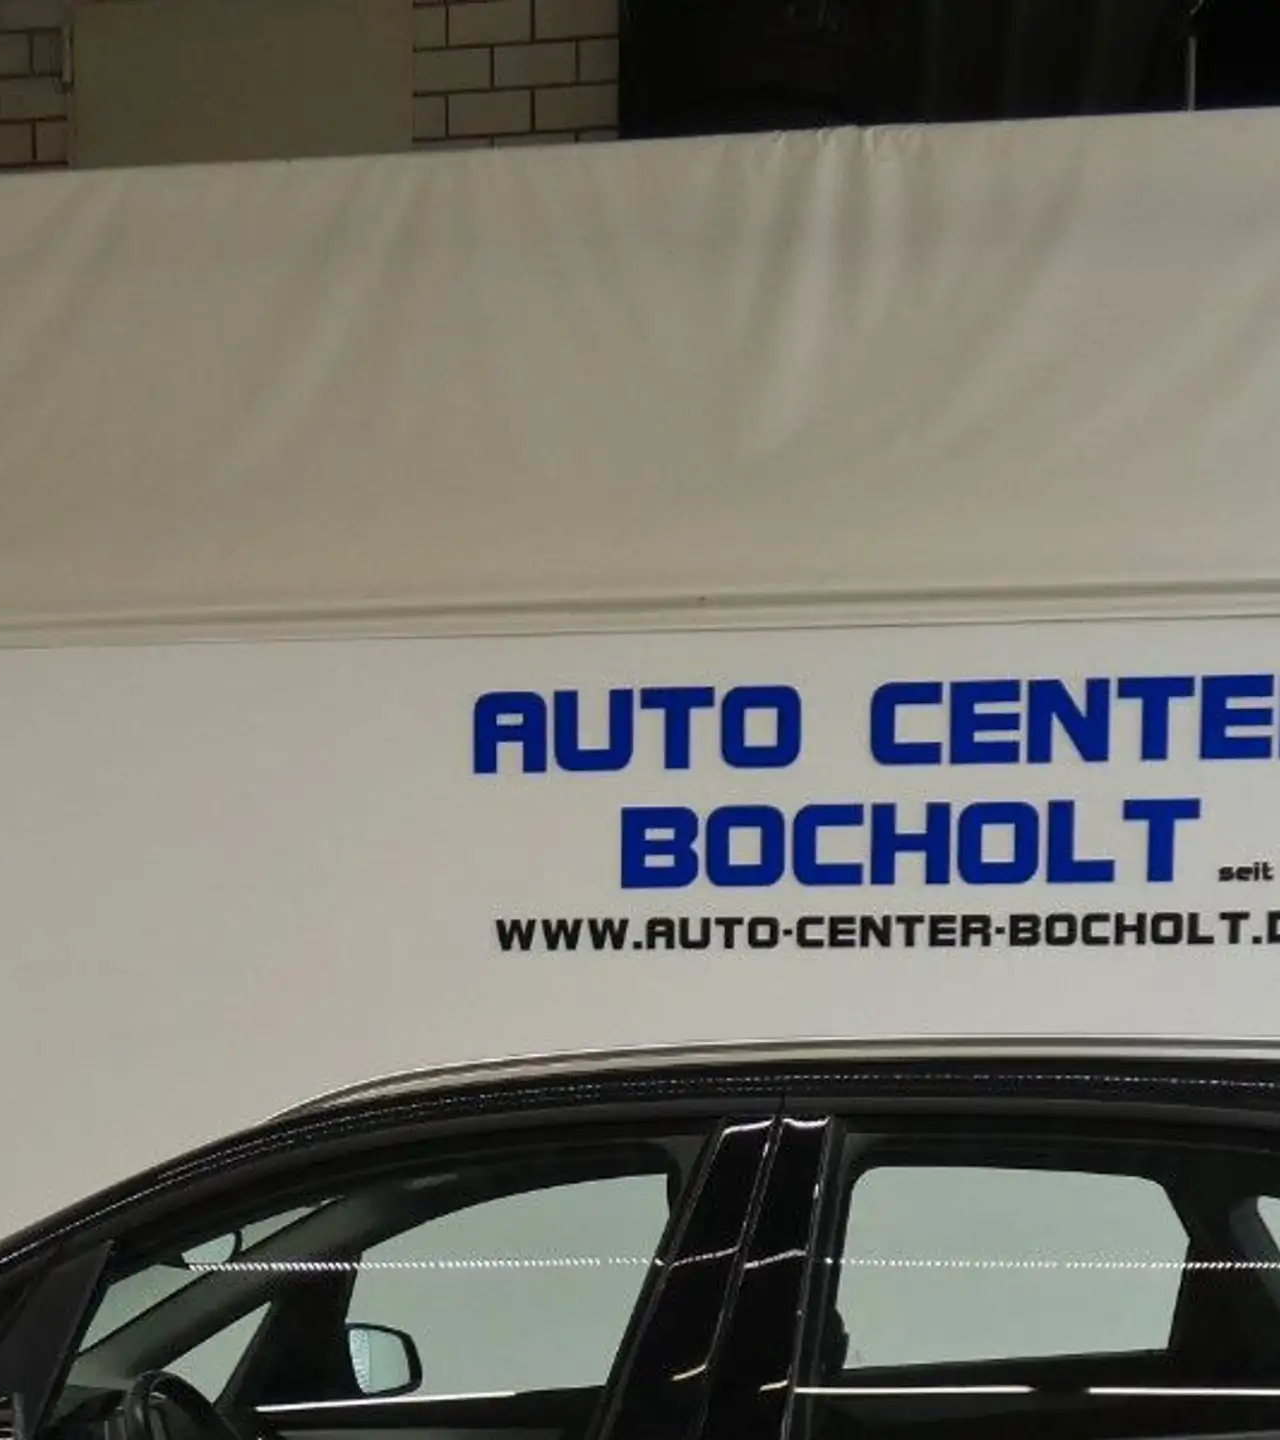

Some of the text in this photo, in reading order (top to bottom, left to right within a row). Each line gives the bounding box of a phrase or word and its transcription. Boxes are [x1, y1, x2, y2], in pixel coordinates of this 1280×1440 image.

[474, 687, 802, 772] AUTO
[621, 796, 1202, 890] BOCHOLT
[1218, 861, 1274, 882] seit
